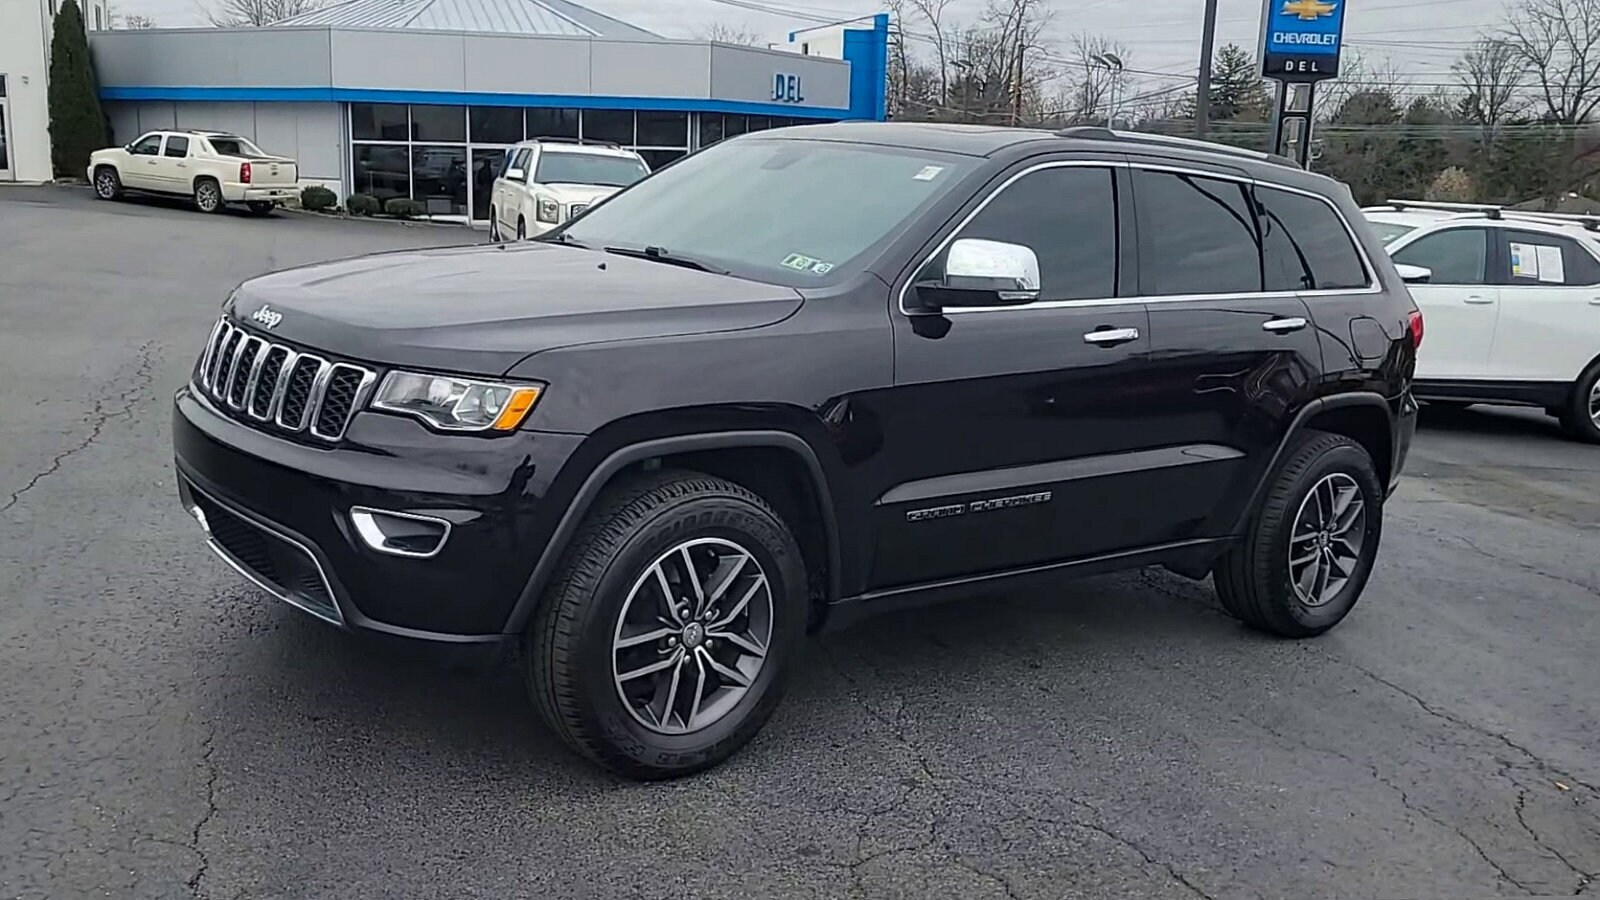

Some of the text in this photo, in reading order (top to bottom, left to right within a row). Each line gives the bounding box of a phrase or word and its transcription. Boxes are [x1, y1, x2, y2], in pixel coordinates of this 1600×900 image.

[1273, 31, 1337, 45] CHEVROLET
[1285, 60, 1319, 72] DEL
[773, 72, 805, 103] DEL
[253, 304, 282, 330] Jeep
[907, 491, 1052, 521] GRAND CHEROKEE
